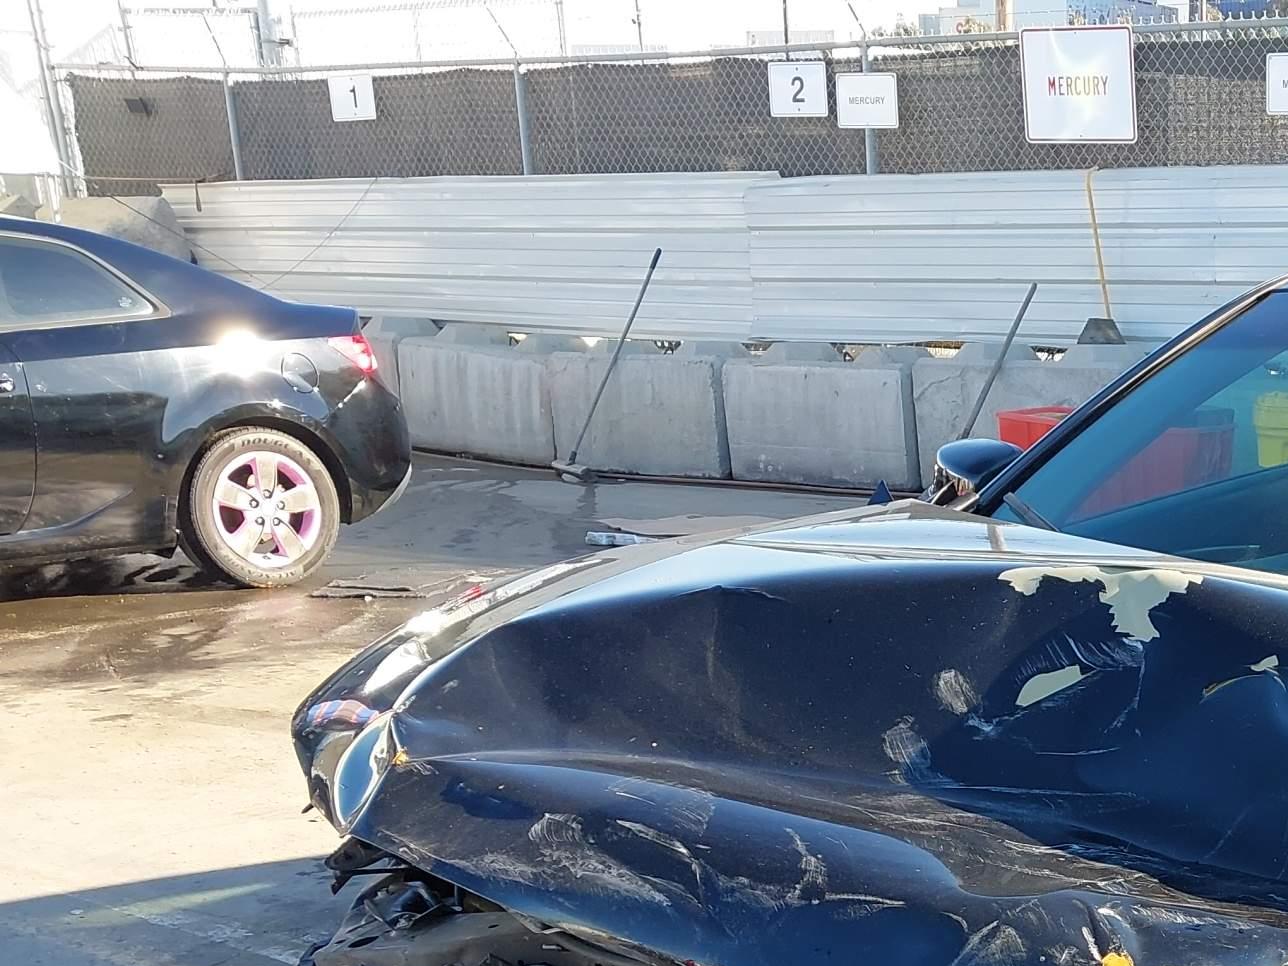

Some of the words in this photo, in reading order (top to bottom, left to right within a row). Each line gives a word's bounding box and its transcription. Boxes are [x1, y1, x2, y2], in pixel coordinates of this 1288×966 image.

[349, 84, 358, 108] 1
[791, 76, 806, 103] 2
[1047, 75, 1108, 97] MERCURY
[848, 95, 886, 105] MERCURY
